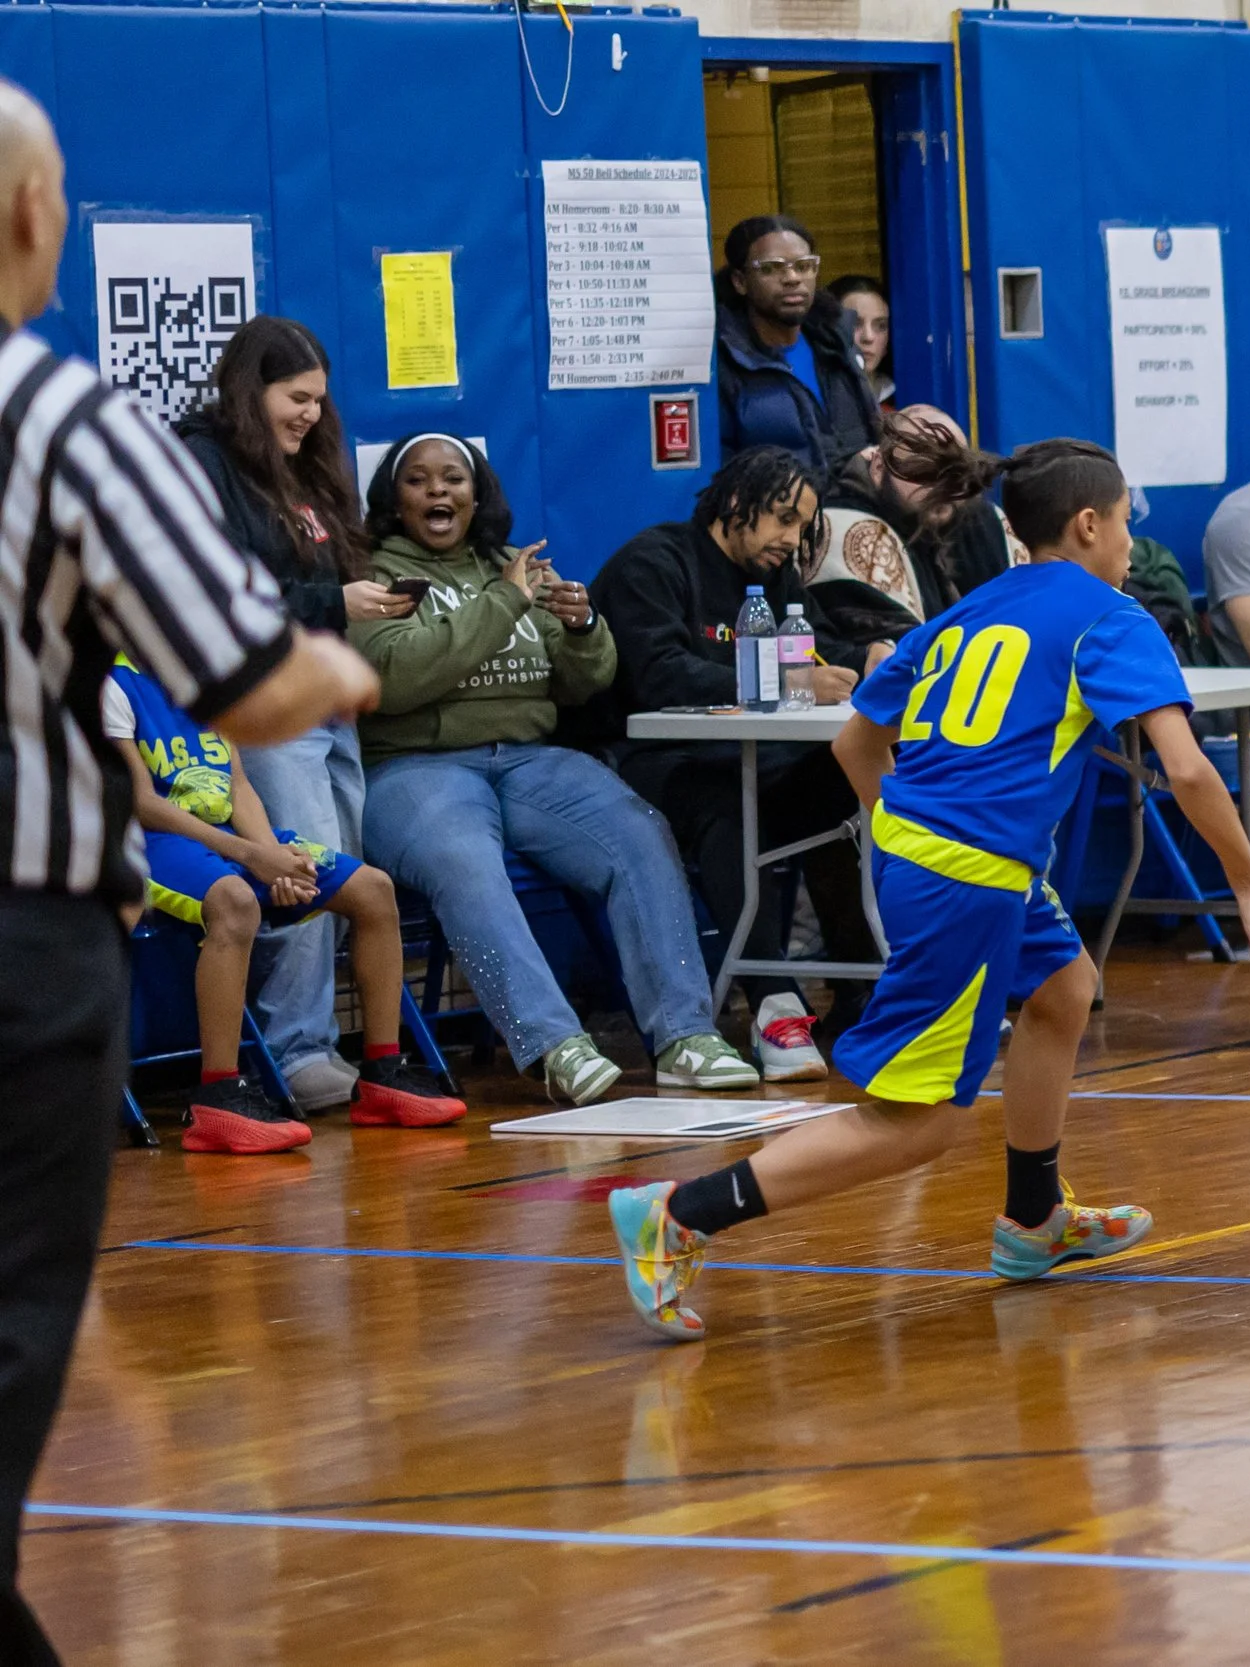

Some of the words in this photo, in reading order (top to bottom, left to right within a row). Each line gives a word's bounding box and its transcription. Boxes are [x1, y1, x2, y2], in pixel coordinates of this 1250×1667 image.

[567, 168, 581, 180] MS
[583, 168, 594, 180] 50
[596, 168, 612, 180] Bell
[614, 168, 652, 180] Schedule
[654, 168, 698, 180] 2024-2025
[546, 204, 560, 215] AM
[562, 204, 610, 214] Homeroom
[666, 203, 680, 214] AM
[547, 223, 560, 234] Per
[564, 223, 568, 234] 1
[624, 222, 638, 232] AM
[548, 242, 562, 253] Per
[564, 242, 569, 253] 2
[630, 241, 644, 252] AM
[549, 260, 562, 271] Per
[565, 260, 570, 271] 3
[580, 260, 604, 271] 10:04
[636, 259, 650, 270] AM
[549, 279, 563, 290] Per
[566, 279, 571, 290] 4
[632, 278, 647, 289] AM
[550, 298, 564, 309] Per
[567, 298, 572, 309] 5
[636, 297, 650, 308] PM
[551, 317, 565, 328] Per
[568, 316, 573, 327] 6
[631, 315, 645, 326] PM
[1123, 325, 1183, 335] PARTICIPATION
[552, 336, 566, 347] Per
[569, 335, 574, 346] 7
[626, 334, 640, 345] PM
[552, 355, 566, 366] Per
[569, 354, 574, 365] 8
[629, 352, 644, 363] PM
[1138, 360, 1170, 372] EFFORT
[550, 374, 564, 385] PM
[567, 373, 617, 384] Homeroom
[671, 369, 685, 380] PM
[507, 658, 526, 670] OF
[900, 624, 1031, 747] 20
